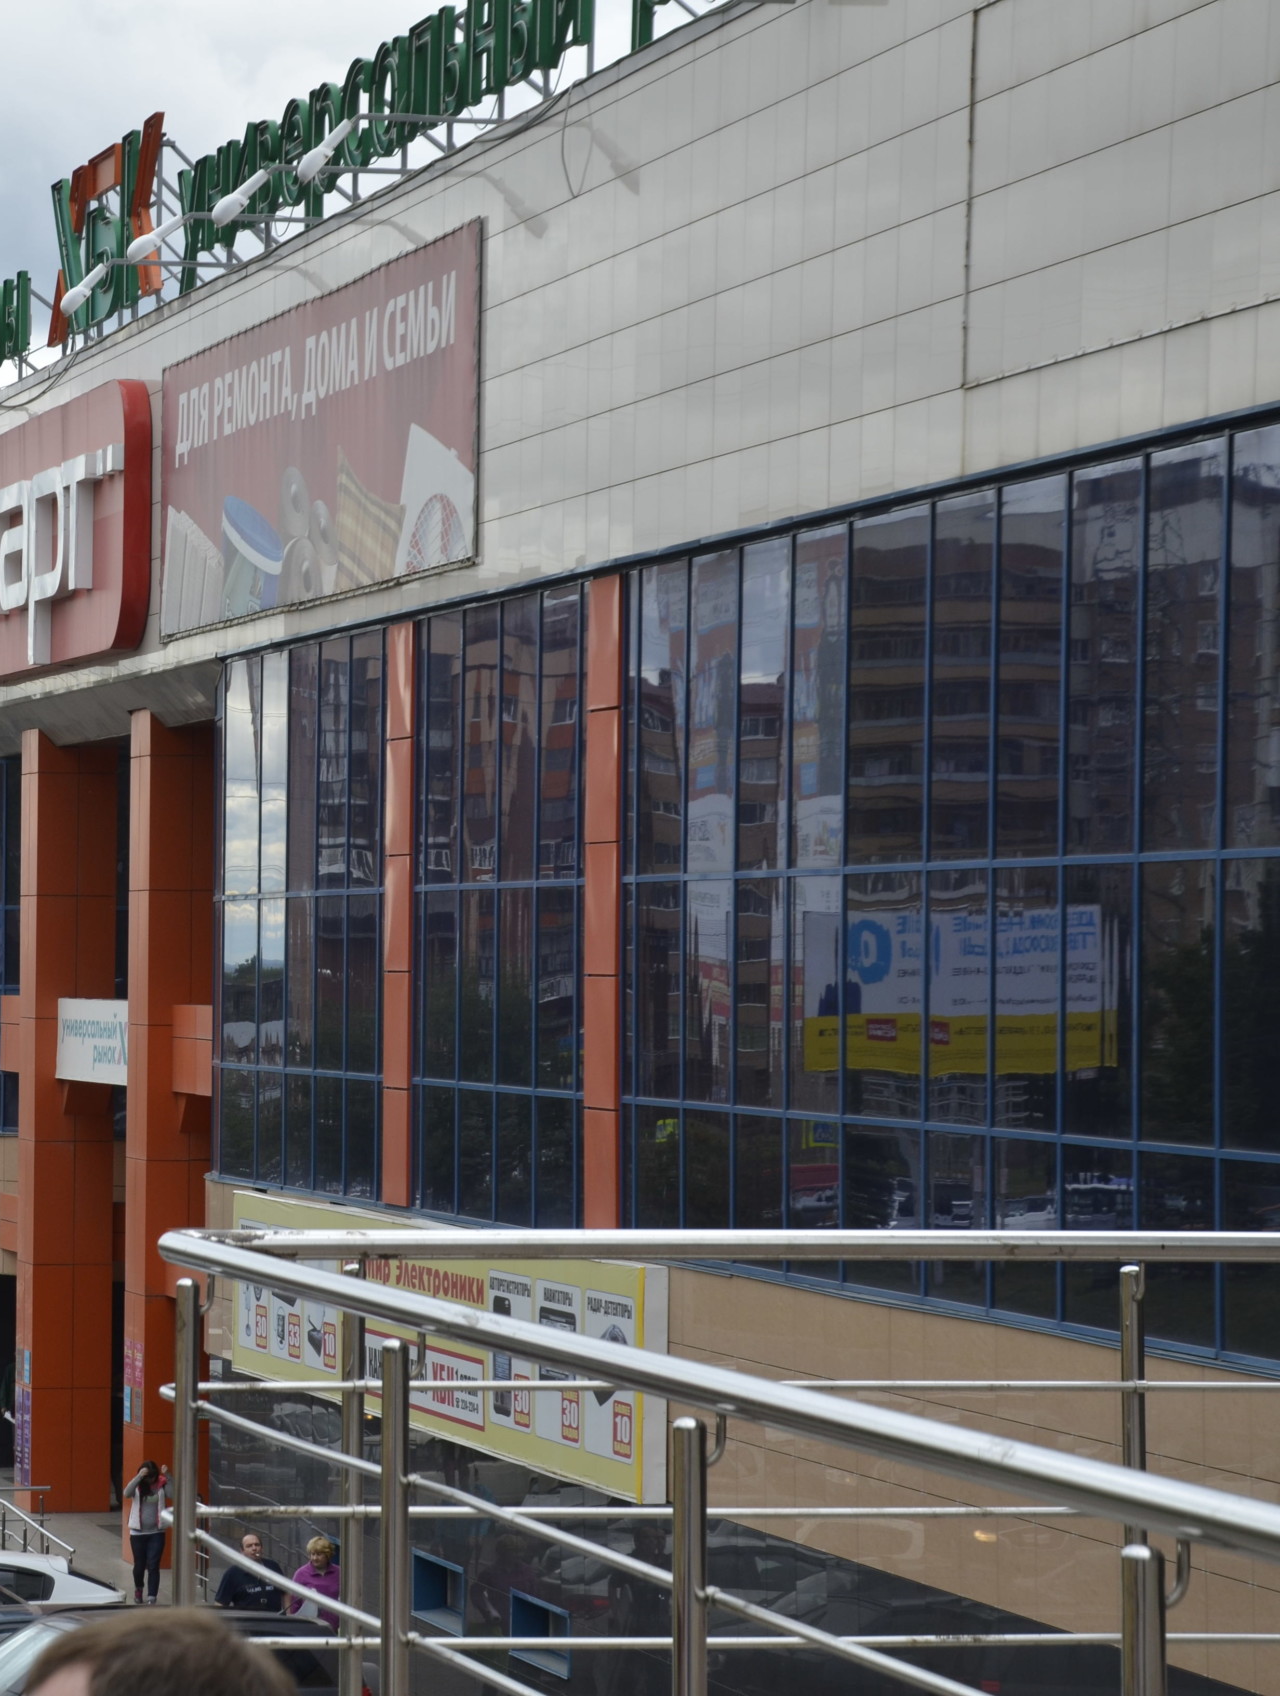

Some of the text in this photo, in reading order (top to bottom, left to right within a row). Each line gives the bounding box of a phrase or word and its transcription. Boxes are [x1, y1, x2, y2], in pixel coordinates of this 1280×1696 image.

[175, 269, 457, 468] ДЛЯ РЕМОНТА, ДОМА И СЕМЬИ
[61, 1012, 117, 1046] универсальный
[92, 1045, 116, 1072] рынок
[395, 1257, 485, 1305] Электроники
[543, 1286, 574, 1307] НАВИГАТОРЫ
[587, 1296, 633, 1320] РАДАР-ДЕТЕКТОРЫ
[256, 1315, 267, 1338] 30
[289, 1324, 300, 1348] 33
[324, 1333, 335, 1357] 10
[514, 1387, 530, 1414] 30
[562, 1400, 579, 1429] 30
[614, 1414, 631, 1444] 10
